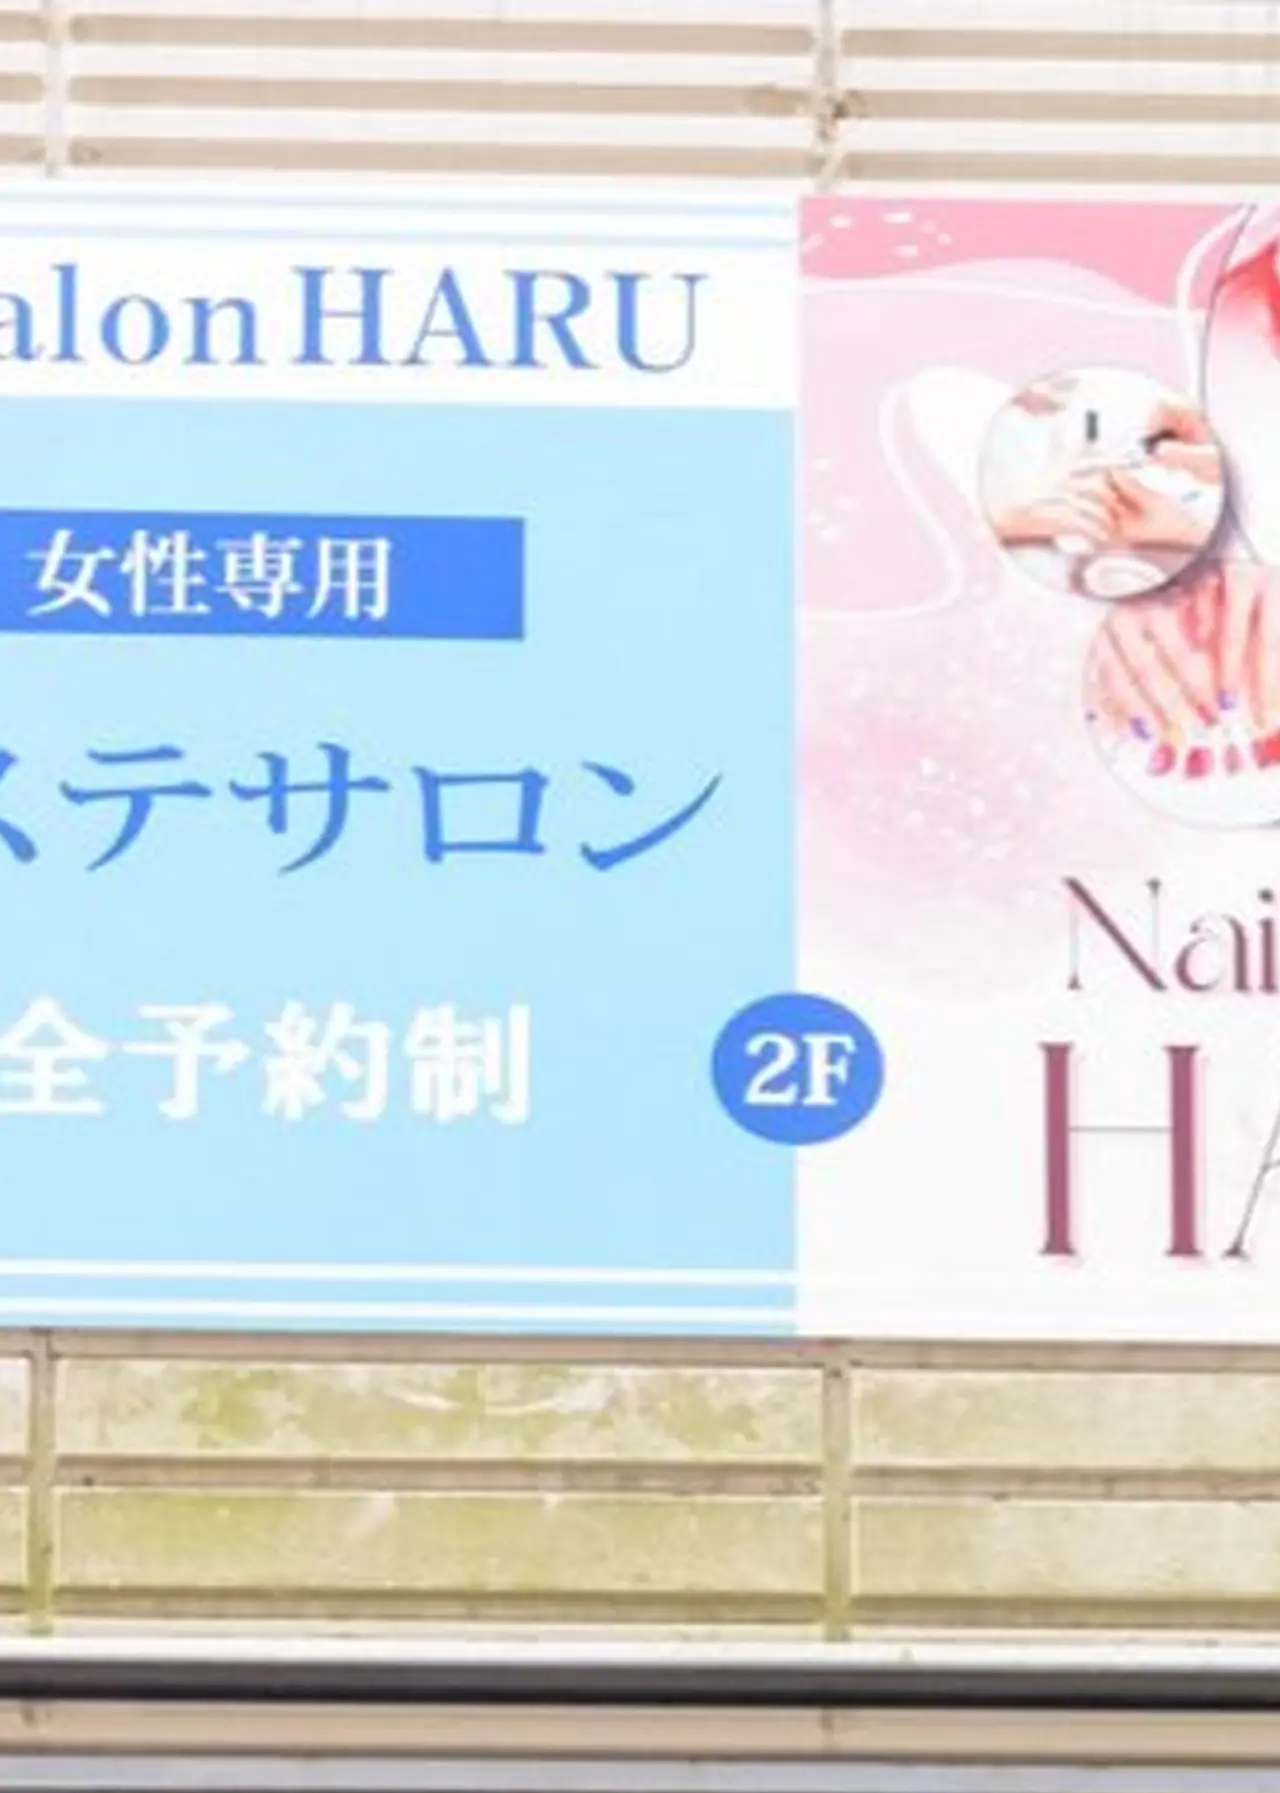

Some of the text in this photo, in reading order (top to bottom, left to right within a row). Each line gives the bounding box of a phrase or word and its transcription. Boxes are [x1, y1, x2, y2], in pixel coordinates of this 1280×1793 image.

[293, 266, 706, 373] HARU
[31, 530, 390, 619] 女性専用
[746, 1034, 855, 1105] 2F
